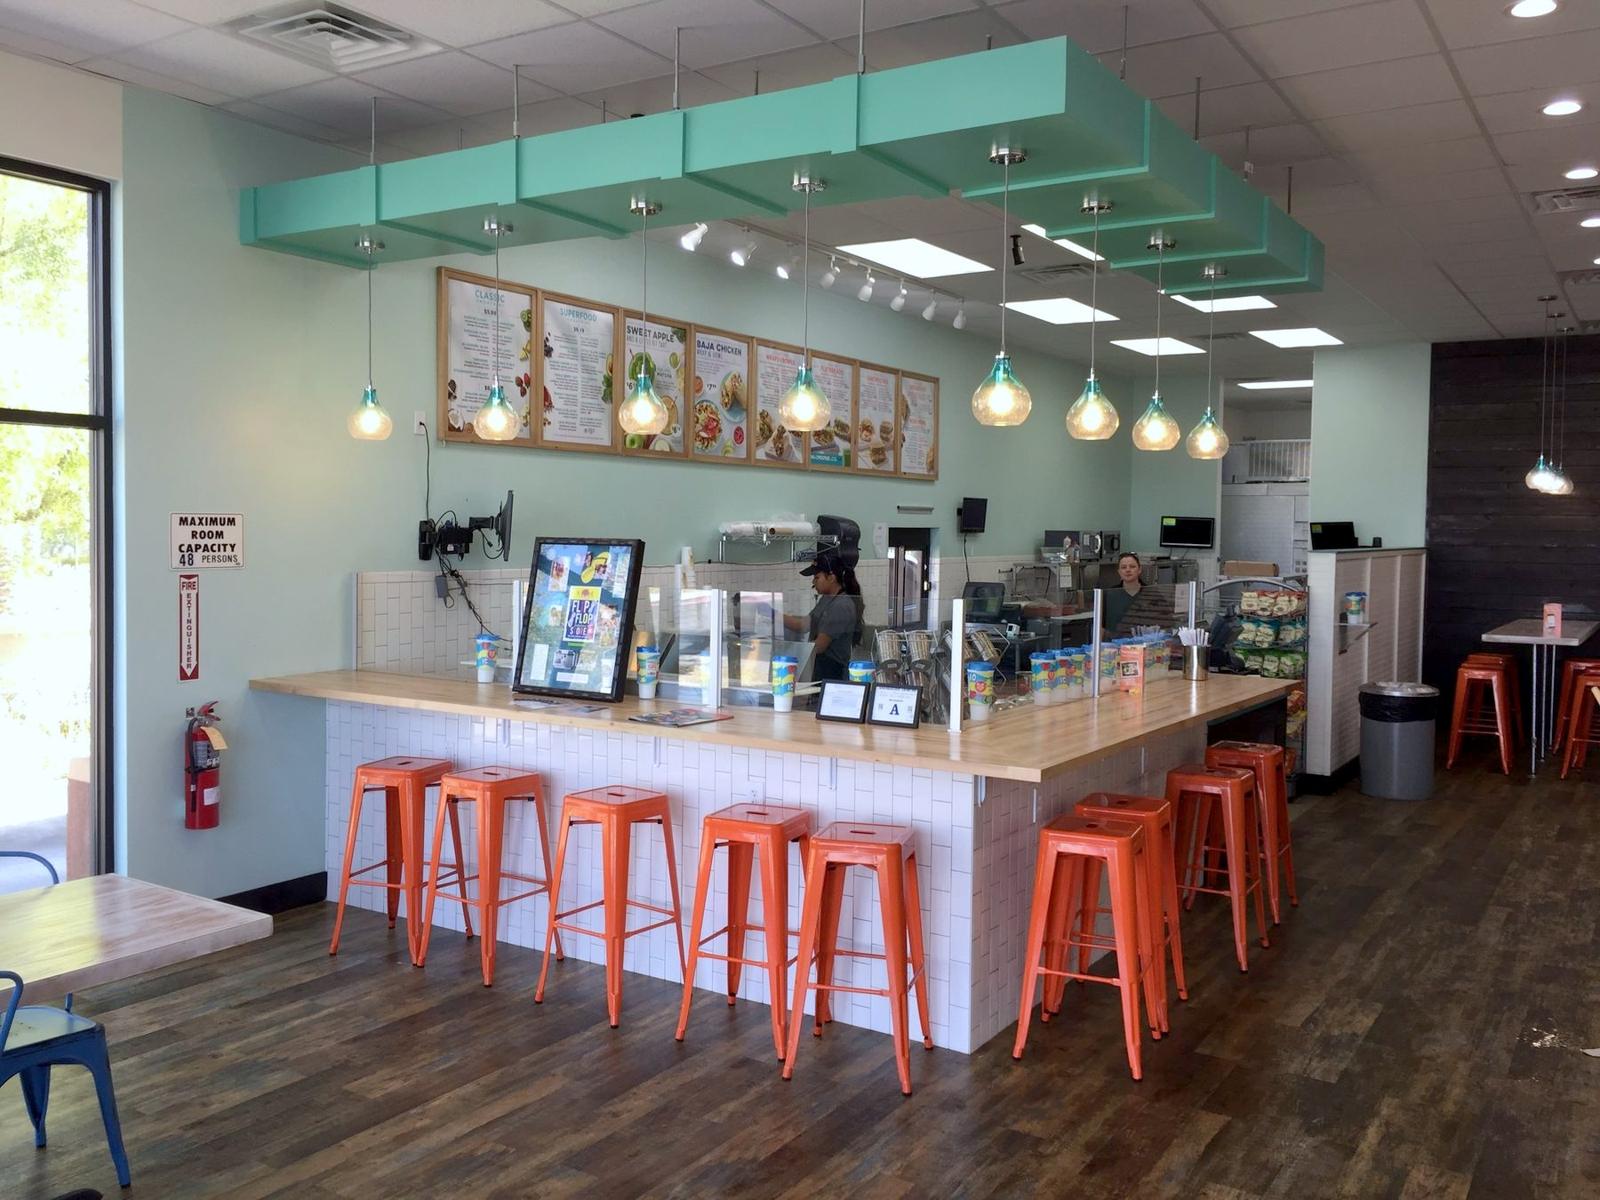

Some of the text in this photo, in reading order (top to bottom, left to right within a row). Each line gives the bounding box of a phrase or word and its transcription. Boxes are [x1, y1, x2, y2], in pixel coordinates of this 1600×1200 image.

[560, 308, 597, 321] SUPERFOOD
[627, 325, 651, 337] SWEET
[653, 331, 675, 342] APPLE
[696, 340, 714, 350] BAJA
[716, 343, 742, 356] CHICKEN
[179, 516, 236, 526] MAXIMUM
[191, 530, 224, 540] ROOM
[178, 543, 236, 553] CAPACITY
[179, 553, 238, 566] 48 PERSONS
[181, 581, 197, 590] FIRE
[575, 612, 593, 625] FLOP
[889, 703, 899, 715] A
